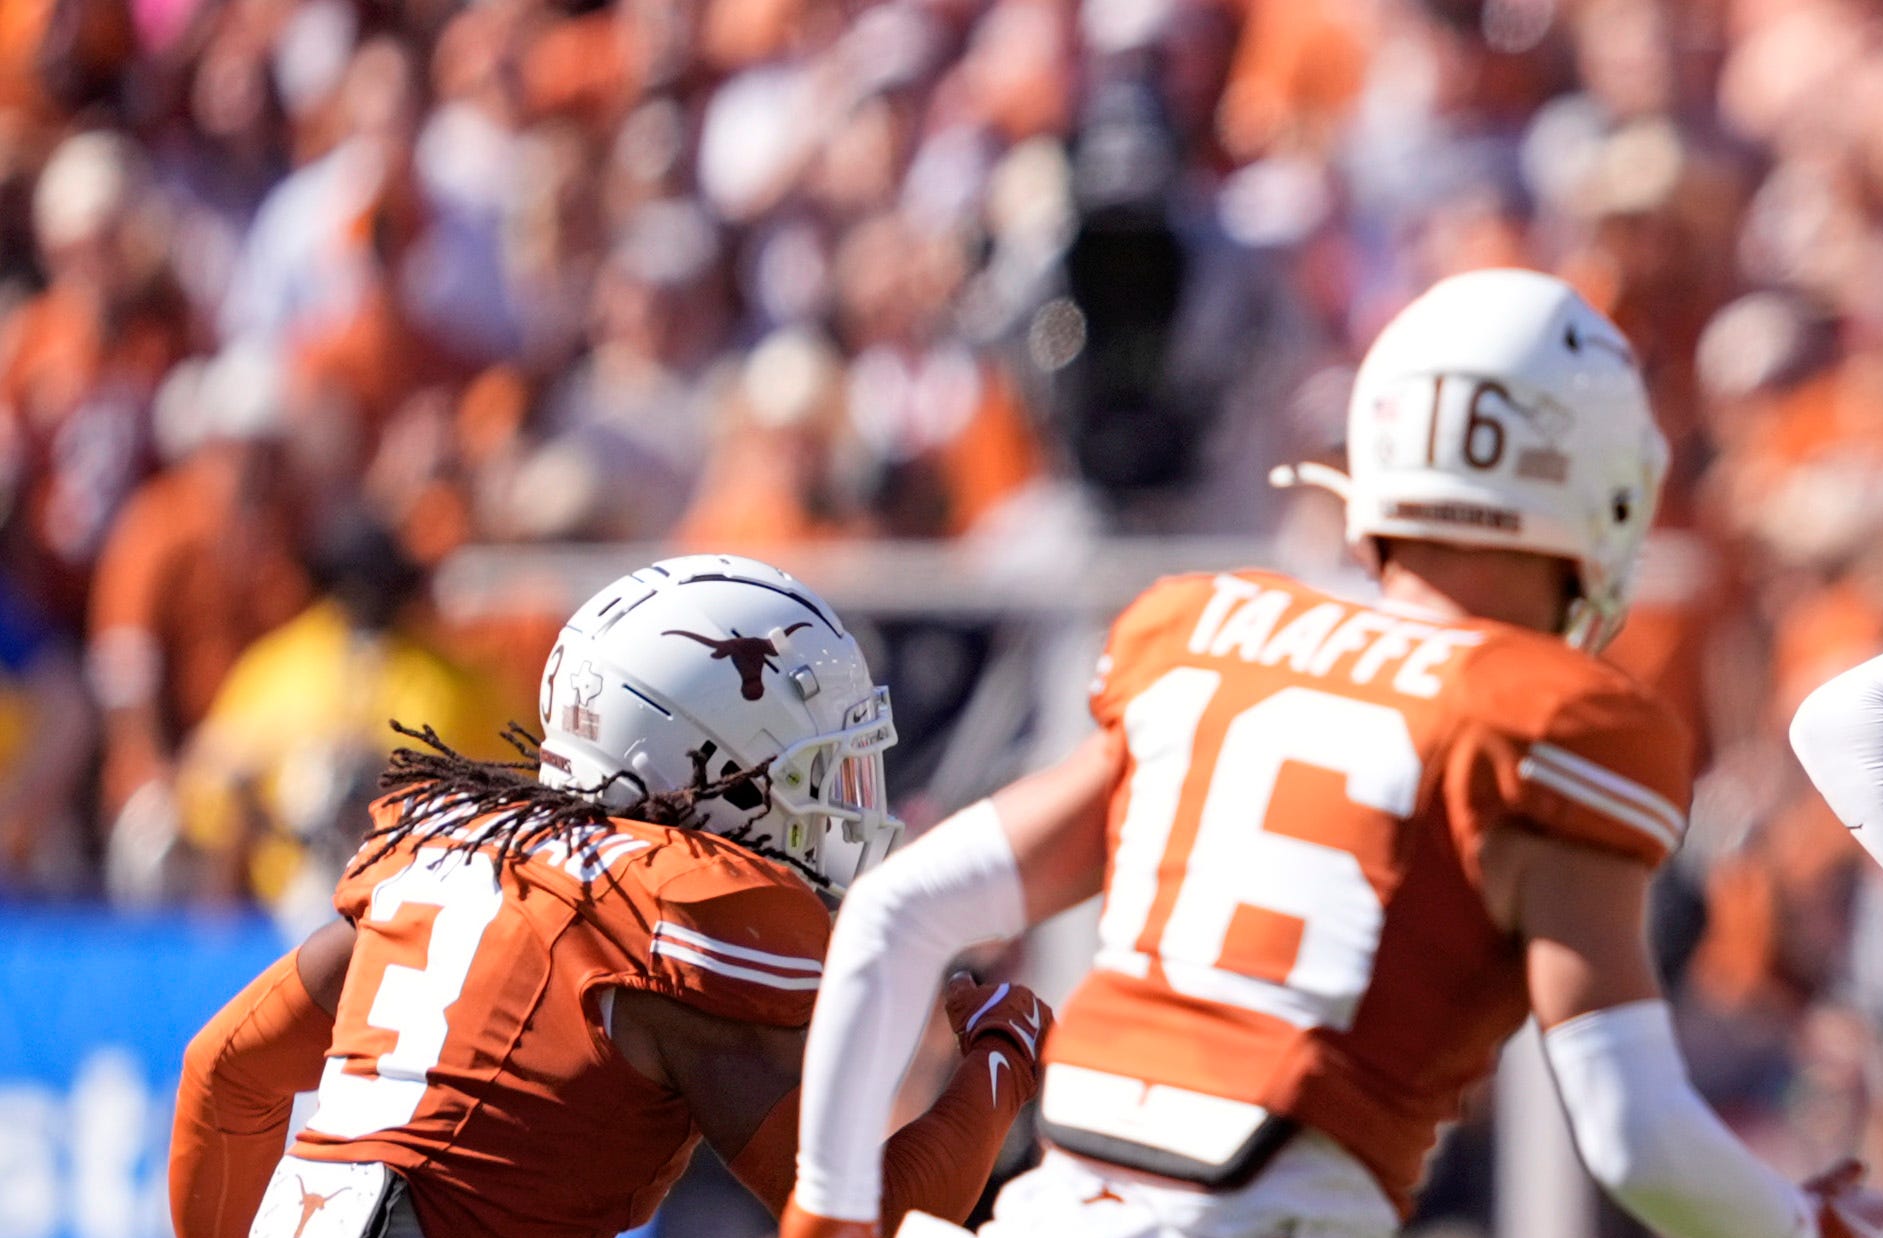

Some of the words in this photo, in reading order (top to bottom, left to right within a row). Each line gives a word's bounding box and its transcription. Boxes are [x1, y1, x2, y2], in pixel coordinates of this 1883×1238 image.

[1426, 375, 1508, 470] 16
[1188, 573, 1488, 698] TAAFFE
[1092, 665, 1422, 1032] 16
[304, 846, 503, 1140] 3
